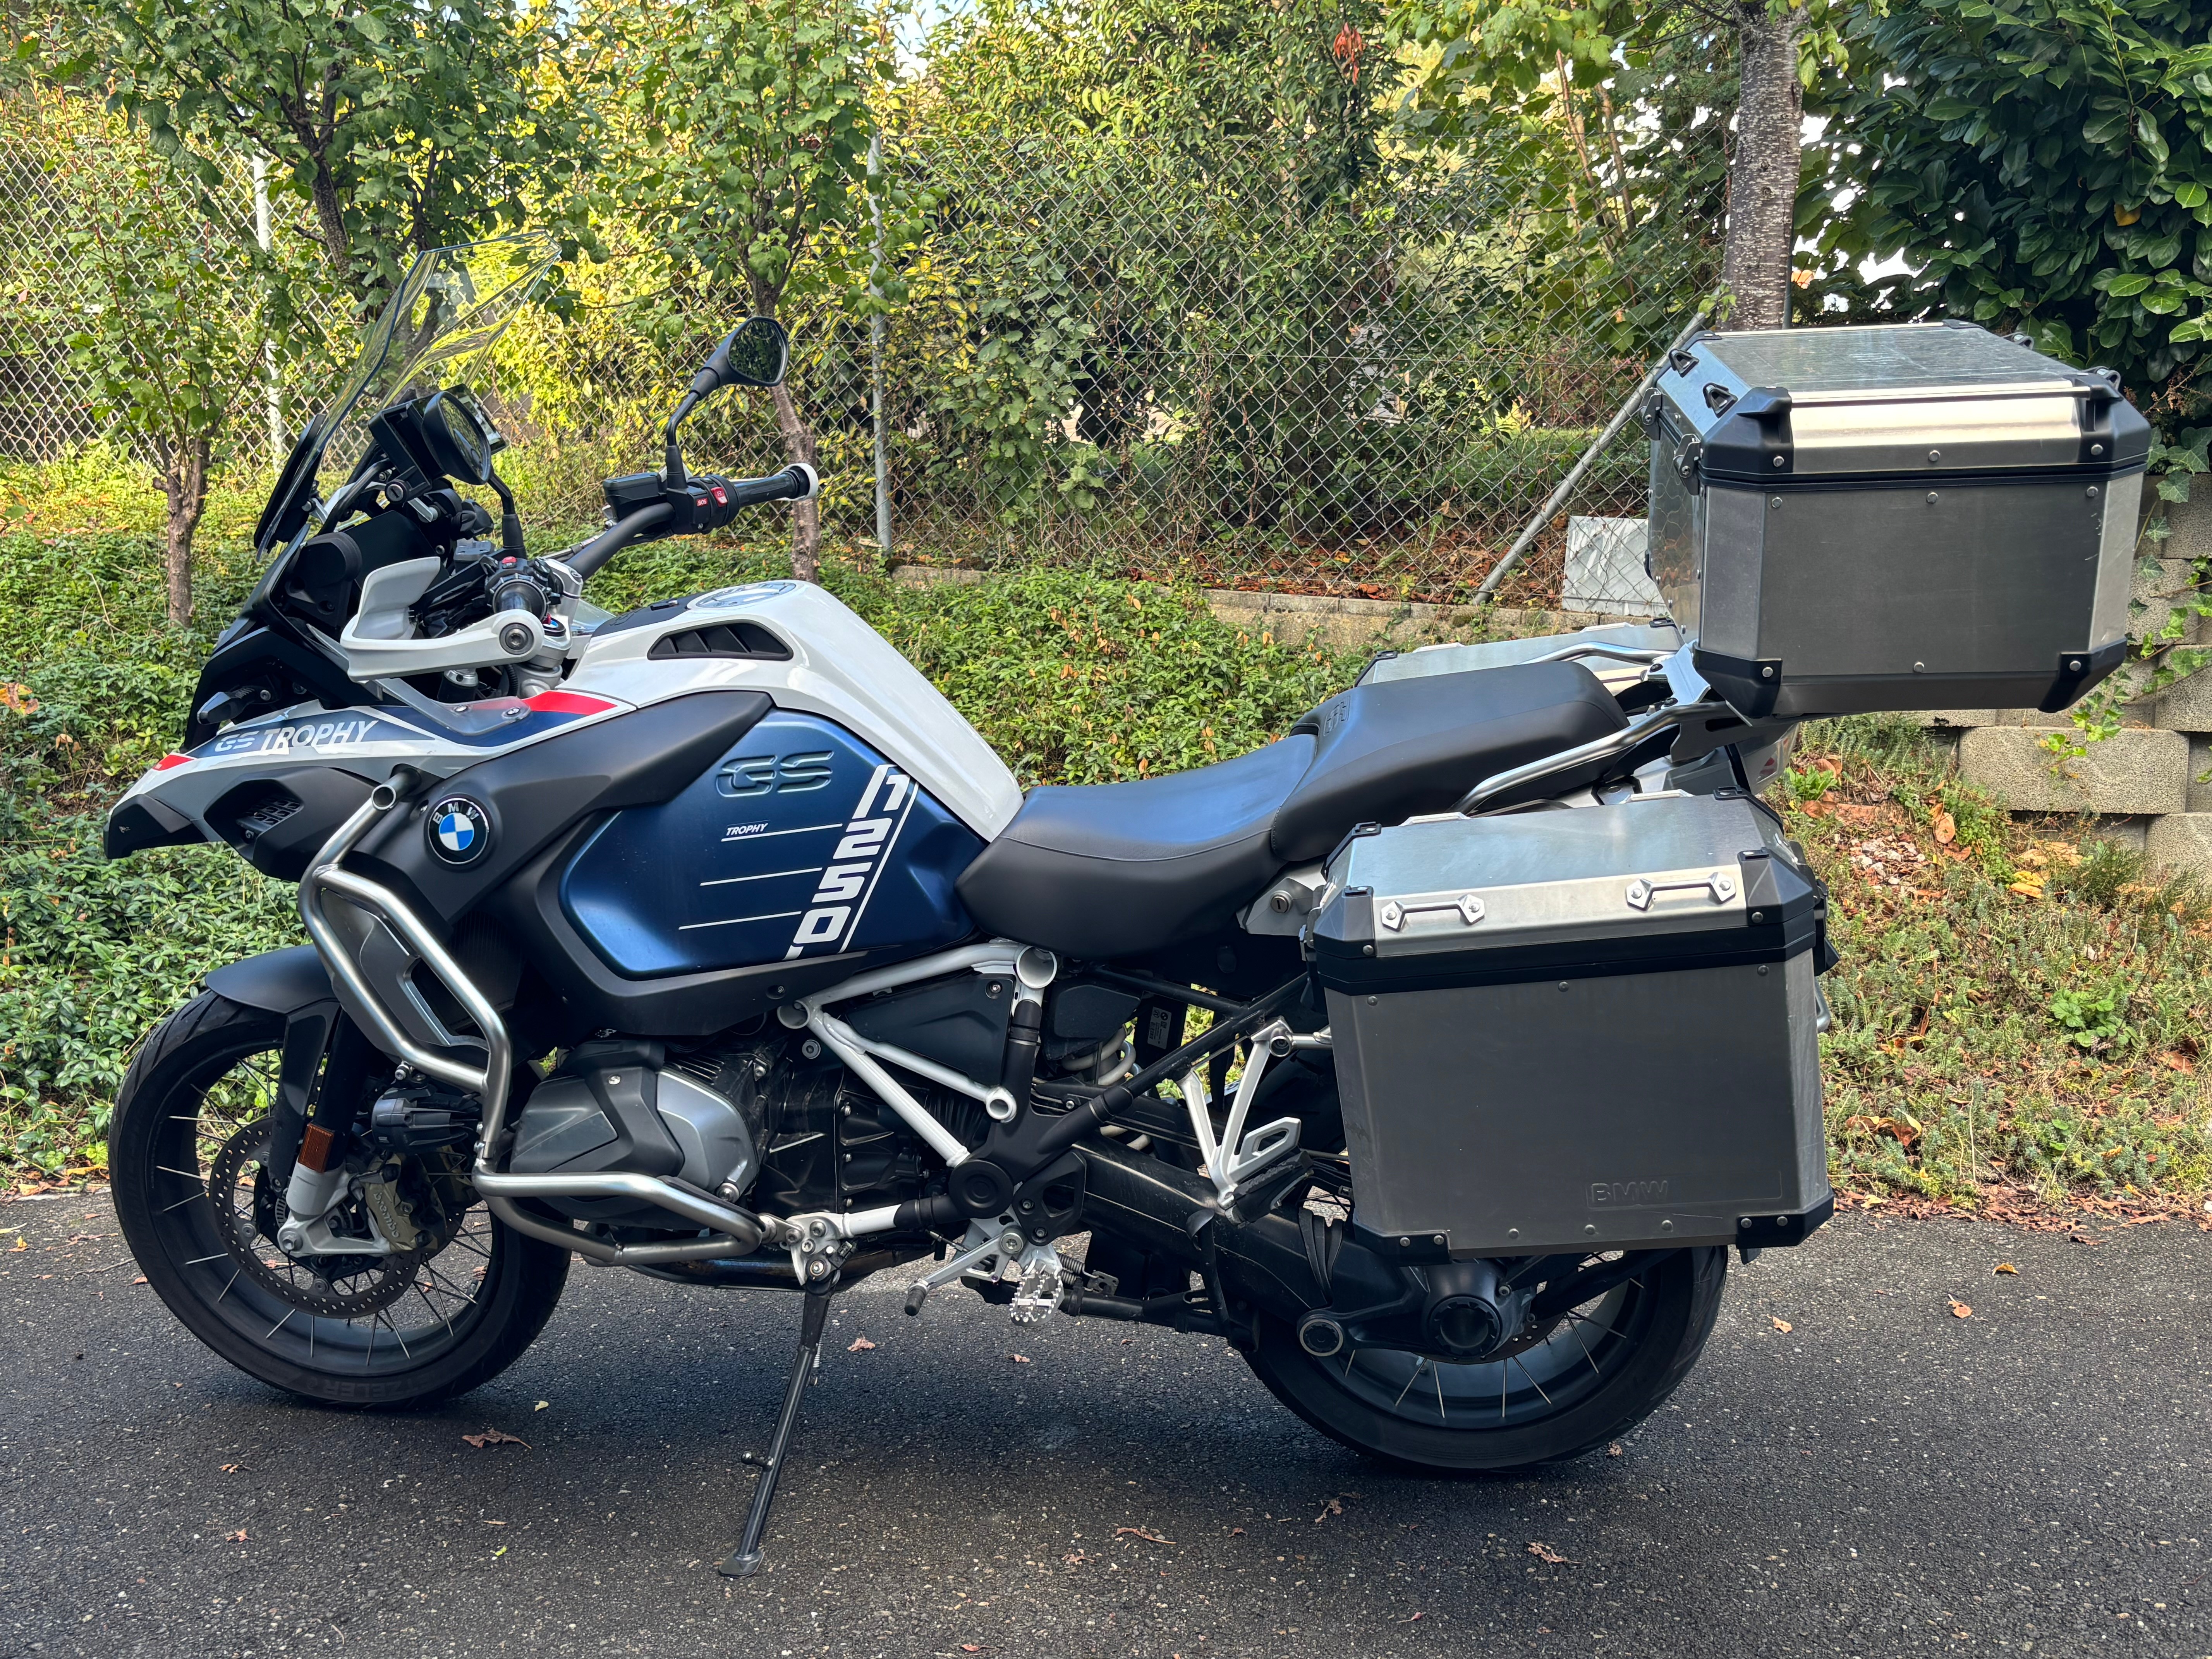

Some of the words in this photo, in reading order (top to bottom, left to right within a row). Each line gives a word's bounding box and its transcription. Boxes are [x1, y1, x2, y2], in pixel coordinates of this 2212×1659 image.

[214, 730, 259, 752] GS
[260, 720, 379, 751] TROPHY
[716, 750, 834, 798] GS
[432, 802, 480, 824] BMW
[726, 823, 769, 836] TROPHY
[793, 774, 911, 944] 1250
[1591, 1180, 1669, 1202] BMW
[373, 1192, 400, 1238] brembo
